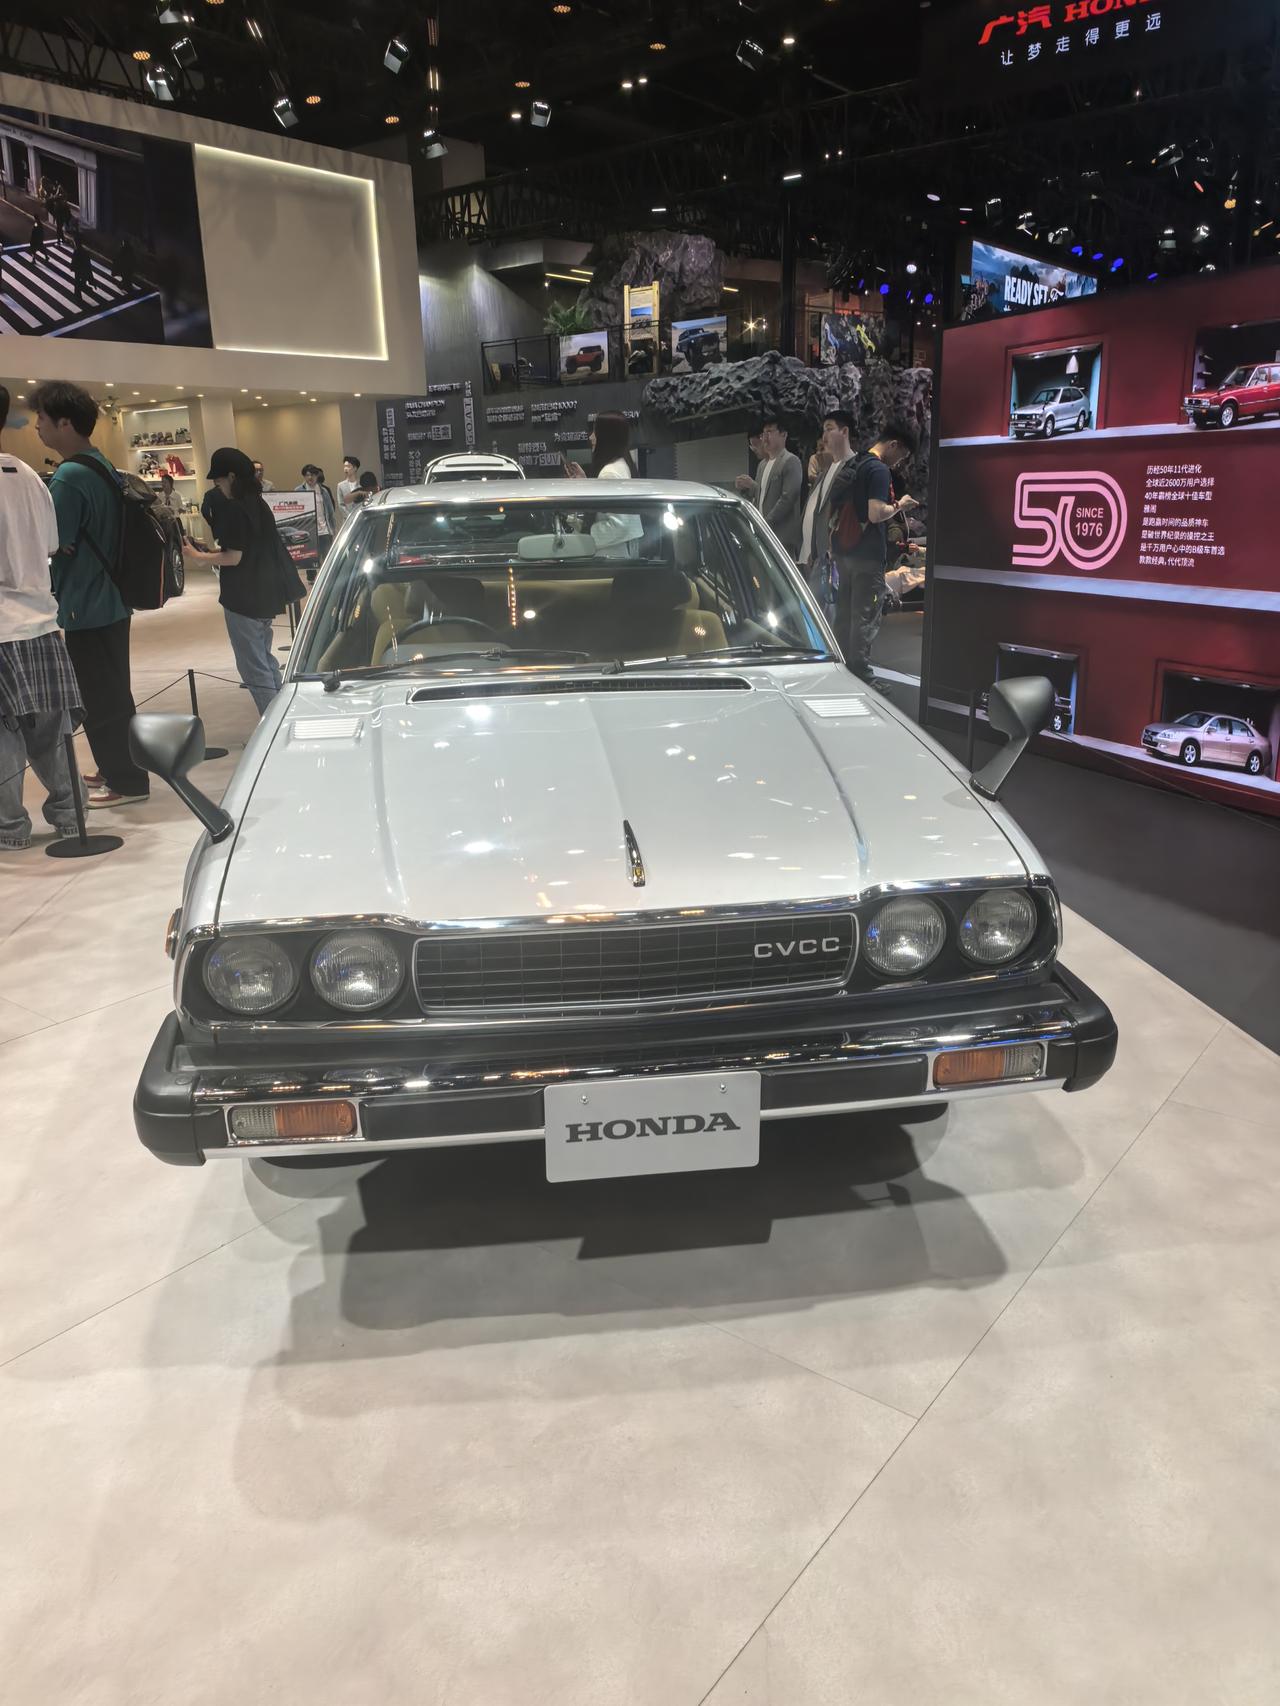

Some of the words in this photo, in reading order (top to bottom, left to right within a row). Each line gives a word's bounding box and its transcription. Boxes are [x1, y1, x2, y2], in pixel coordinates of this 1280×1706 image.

[978, 5, 1052, 45] 广汽
[1001, 12, 1161, 66] 让梦走得更远
[1004, 275, 1033, 306] READY
[1145, 477, 1214, 487] 全球近2600万用户选择
[1146, 464, 1202, 474] 历经50年11代进化
[1011, 470, 1128, 571] 50
[1076, 507, 1104, 519] SINCE
[1075, 522, 1103, 537] 1976
[754, 937, 839, 958] CVCC
[565, 1112, 741, 1143] HONDA
